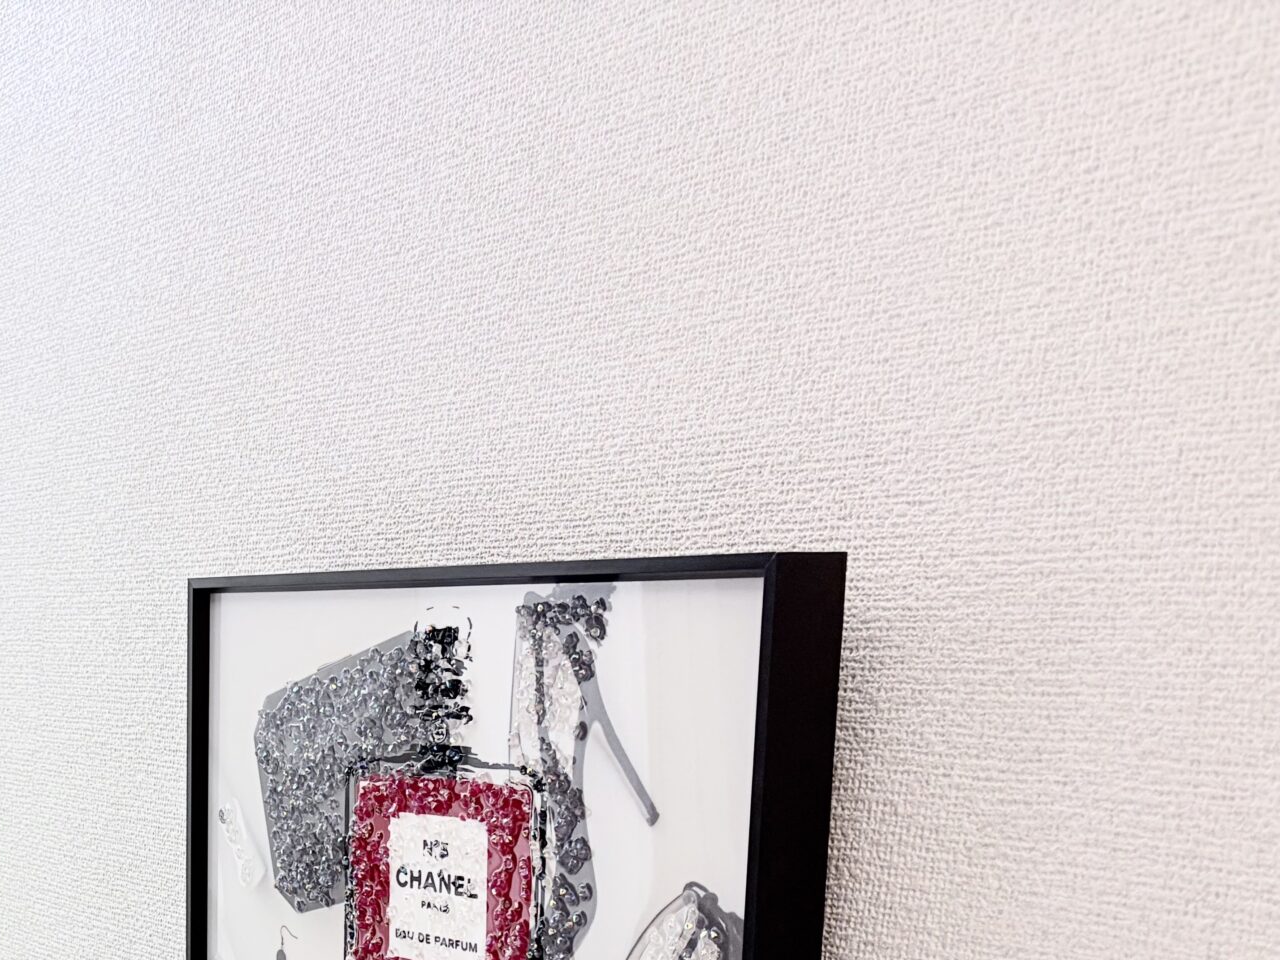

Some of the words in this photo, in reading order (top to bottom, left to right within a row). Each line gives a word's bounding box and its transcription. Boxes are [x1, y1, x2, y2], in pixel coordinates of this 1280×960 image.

[395, 866, 479, 899] CHANEL
[418, 932, 431, 944] DE
[434, 936, 478, 953] PARFUM
